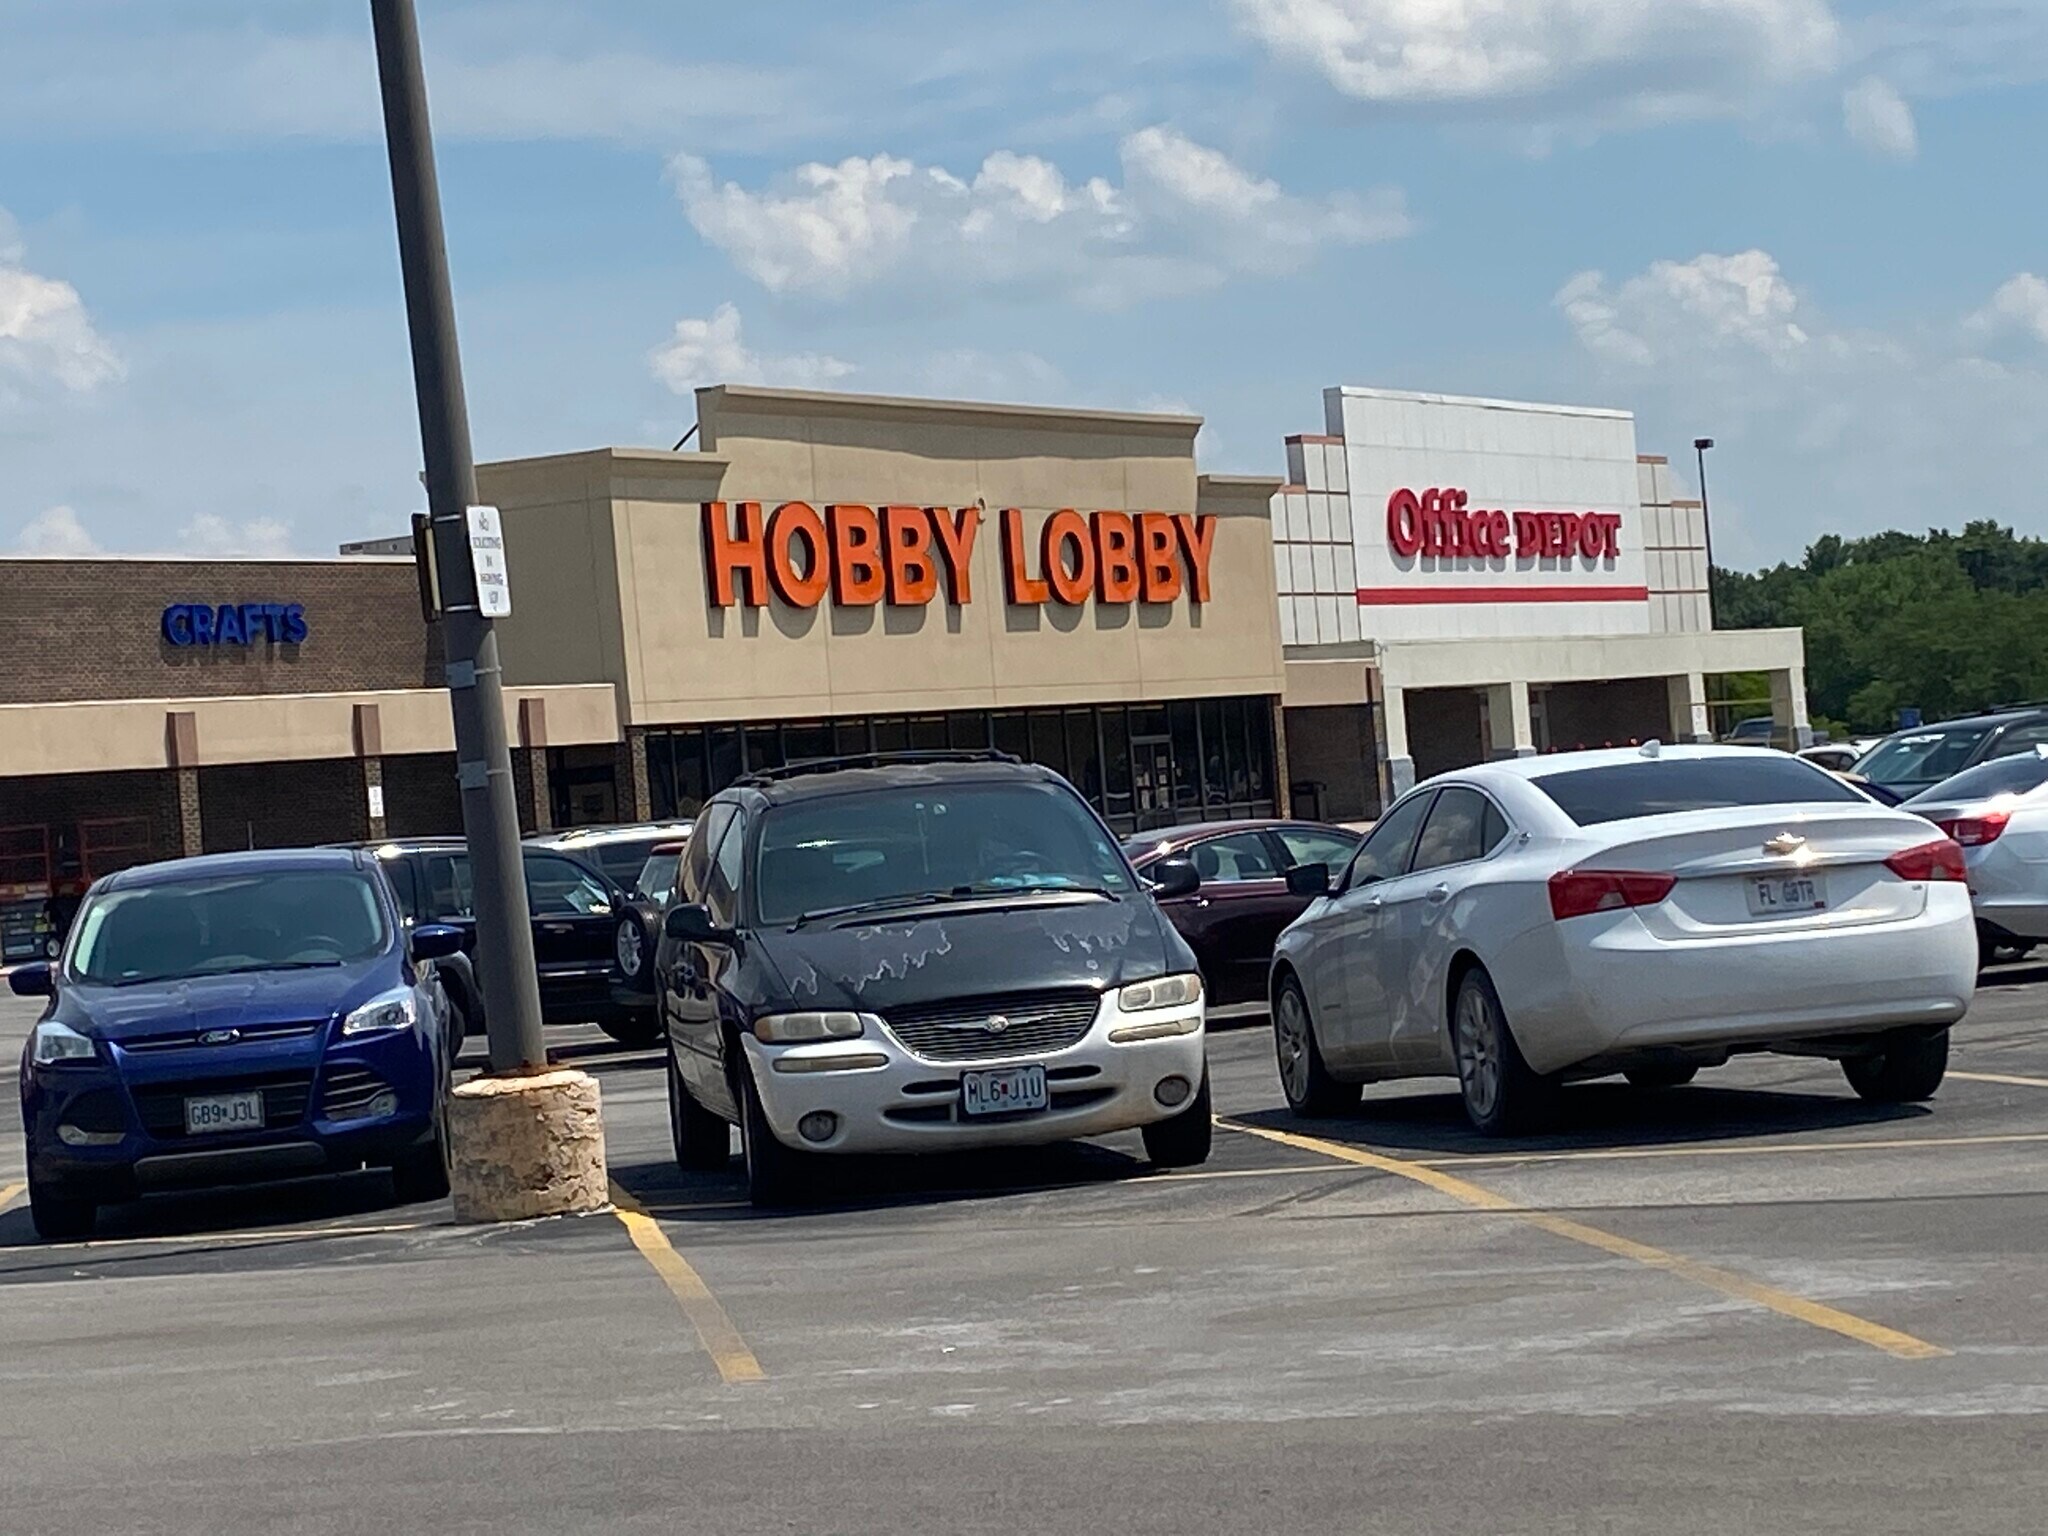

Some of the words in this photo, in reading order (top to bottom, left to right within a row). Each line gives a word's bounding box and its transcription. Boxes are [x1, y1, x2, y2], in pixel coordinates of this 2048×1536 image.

[701, 500, 980, 608] HOBBY
[1000, 508, 1217, 605] LOBBY
[1388, 487, 1510, 558] Office
[1512, 511, 1622, 558] DEPOT
[161, 603, 308, 646] CRAFTS
